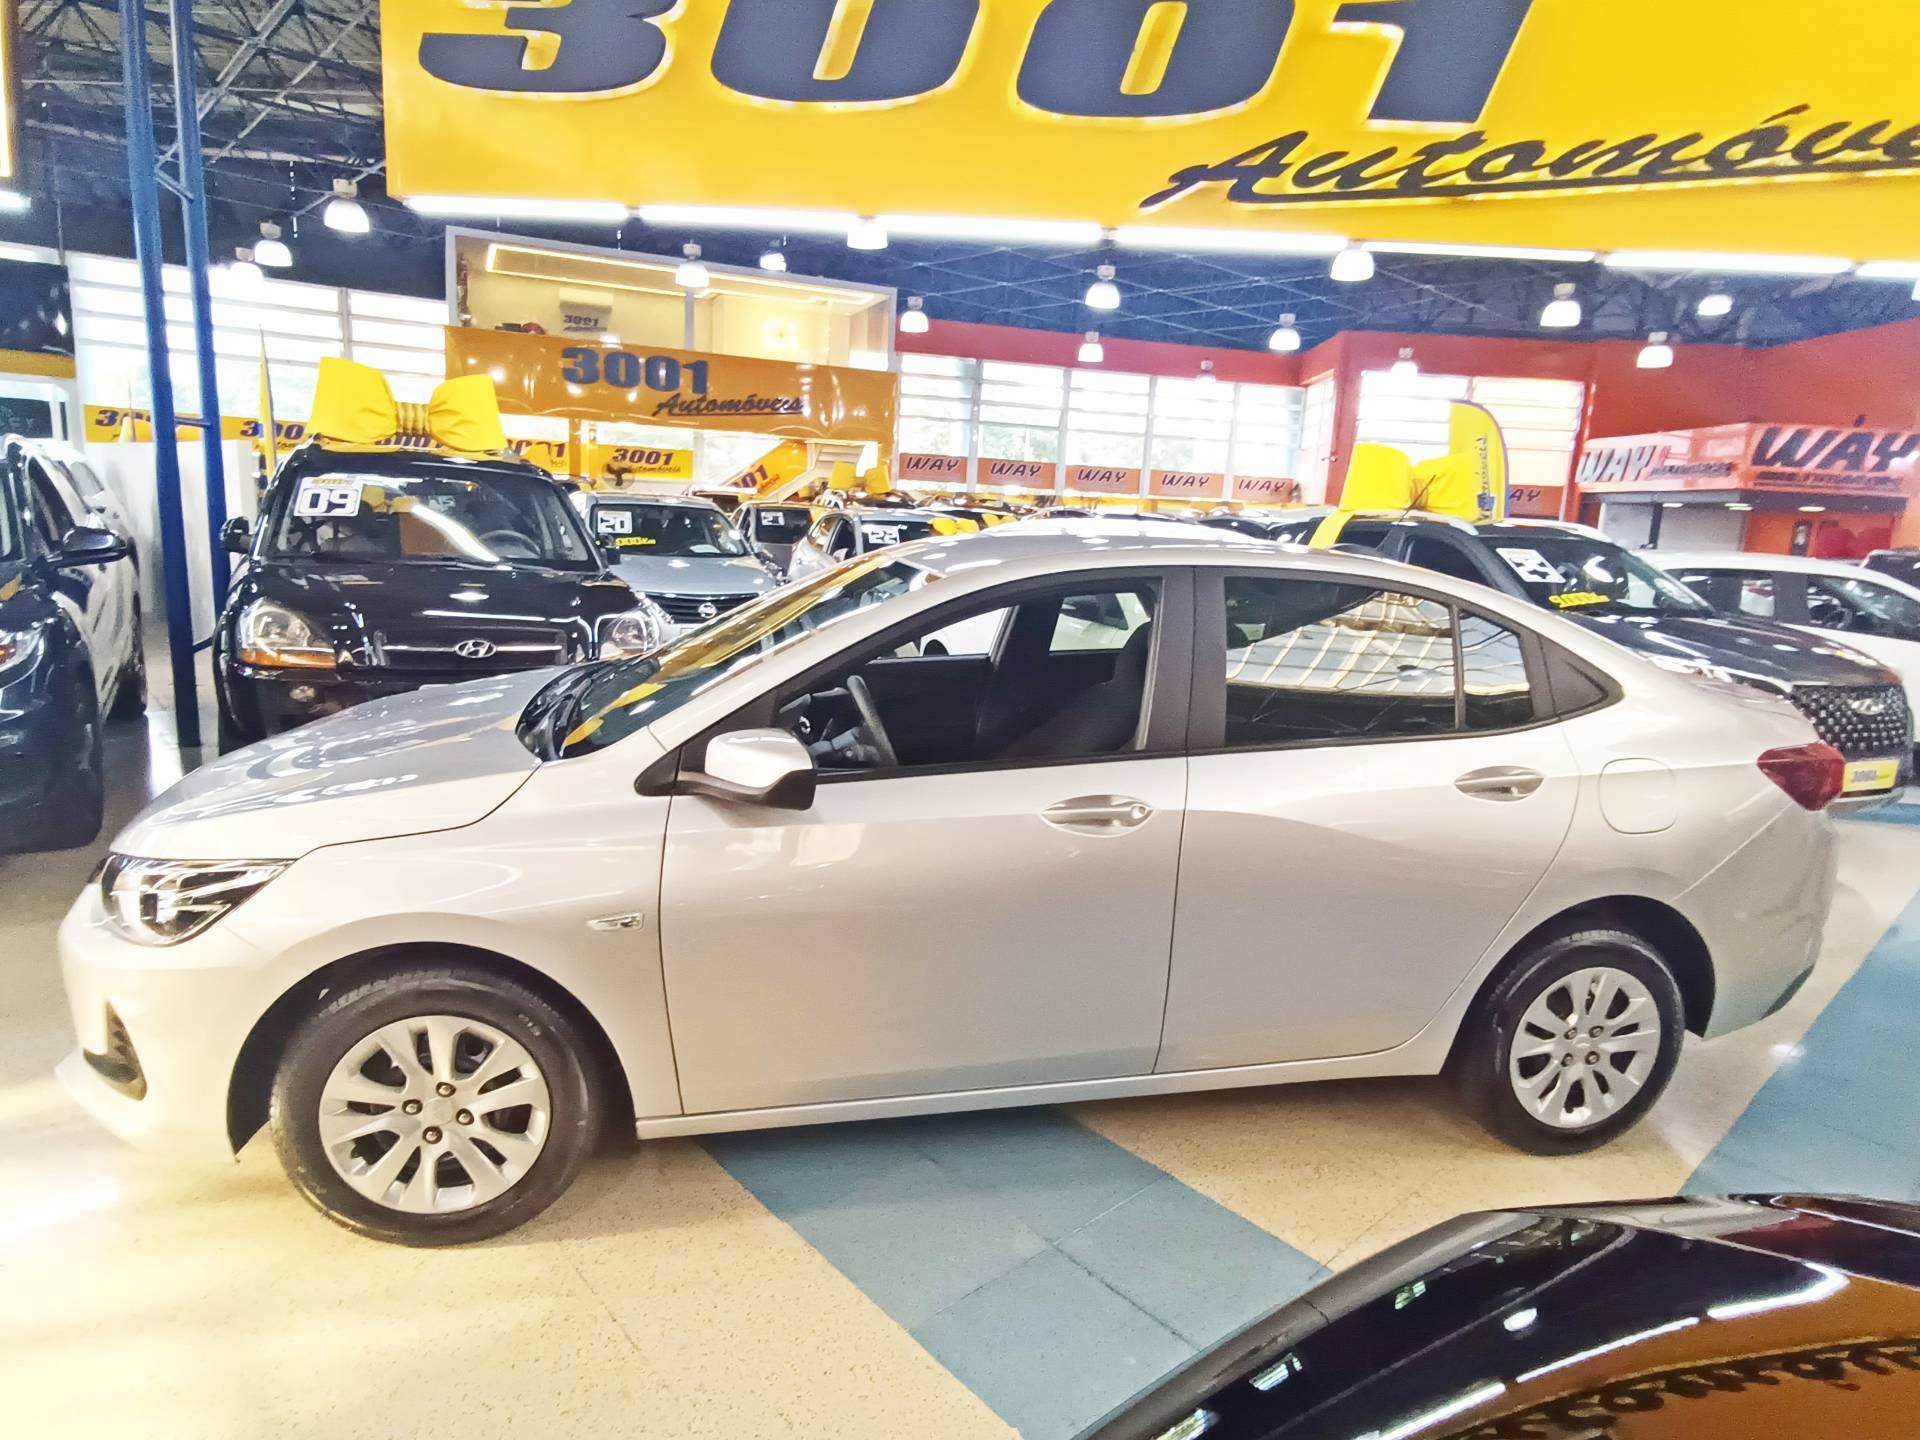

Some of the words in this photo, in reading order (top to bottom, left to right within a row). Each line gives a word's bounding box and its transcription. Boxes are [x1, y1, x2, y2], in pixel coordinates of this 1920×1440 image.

[561, 346, 709, 394] 3001
[612, 447, 674, 466] 3001
[1751, 426, 1920, 472] WAY
[906, 457, 960, 471] WAY
[990, 462, 1042, 477] WAY
[1576, 445, 1657, 482] WAY
[1077, 468, 1127, 483] WAY
[1162, 474, 1210, 487] WAY
[1238, 479, 1286, 493] WAY
[300, 488, 358, 514] 09
[1508, 488, 1541, 502] AY
[599, 516, 630, 532] 20
[869, 529, 898, 544] 22
